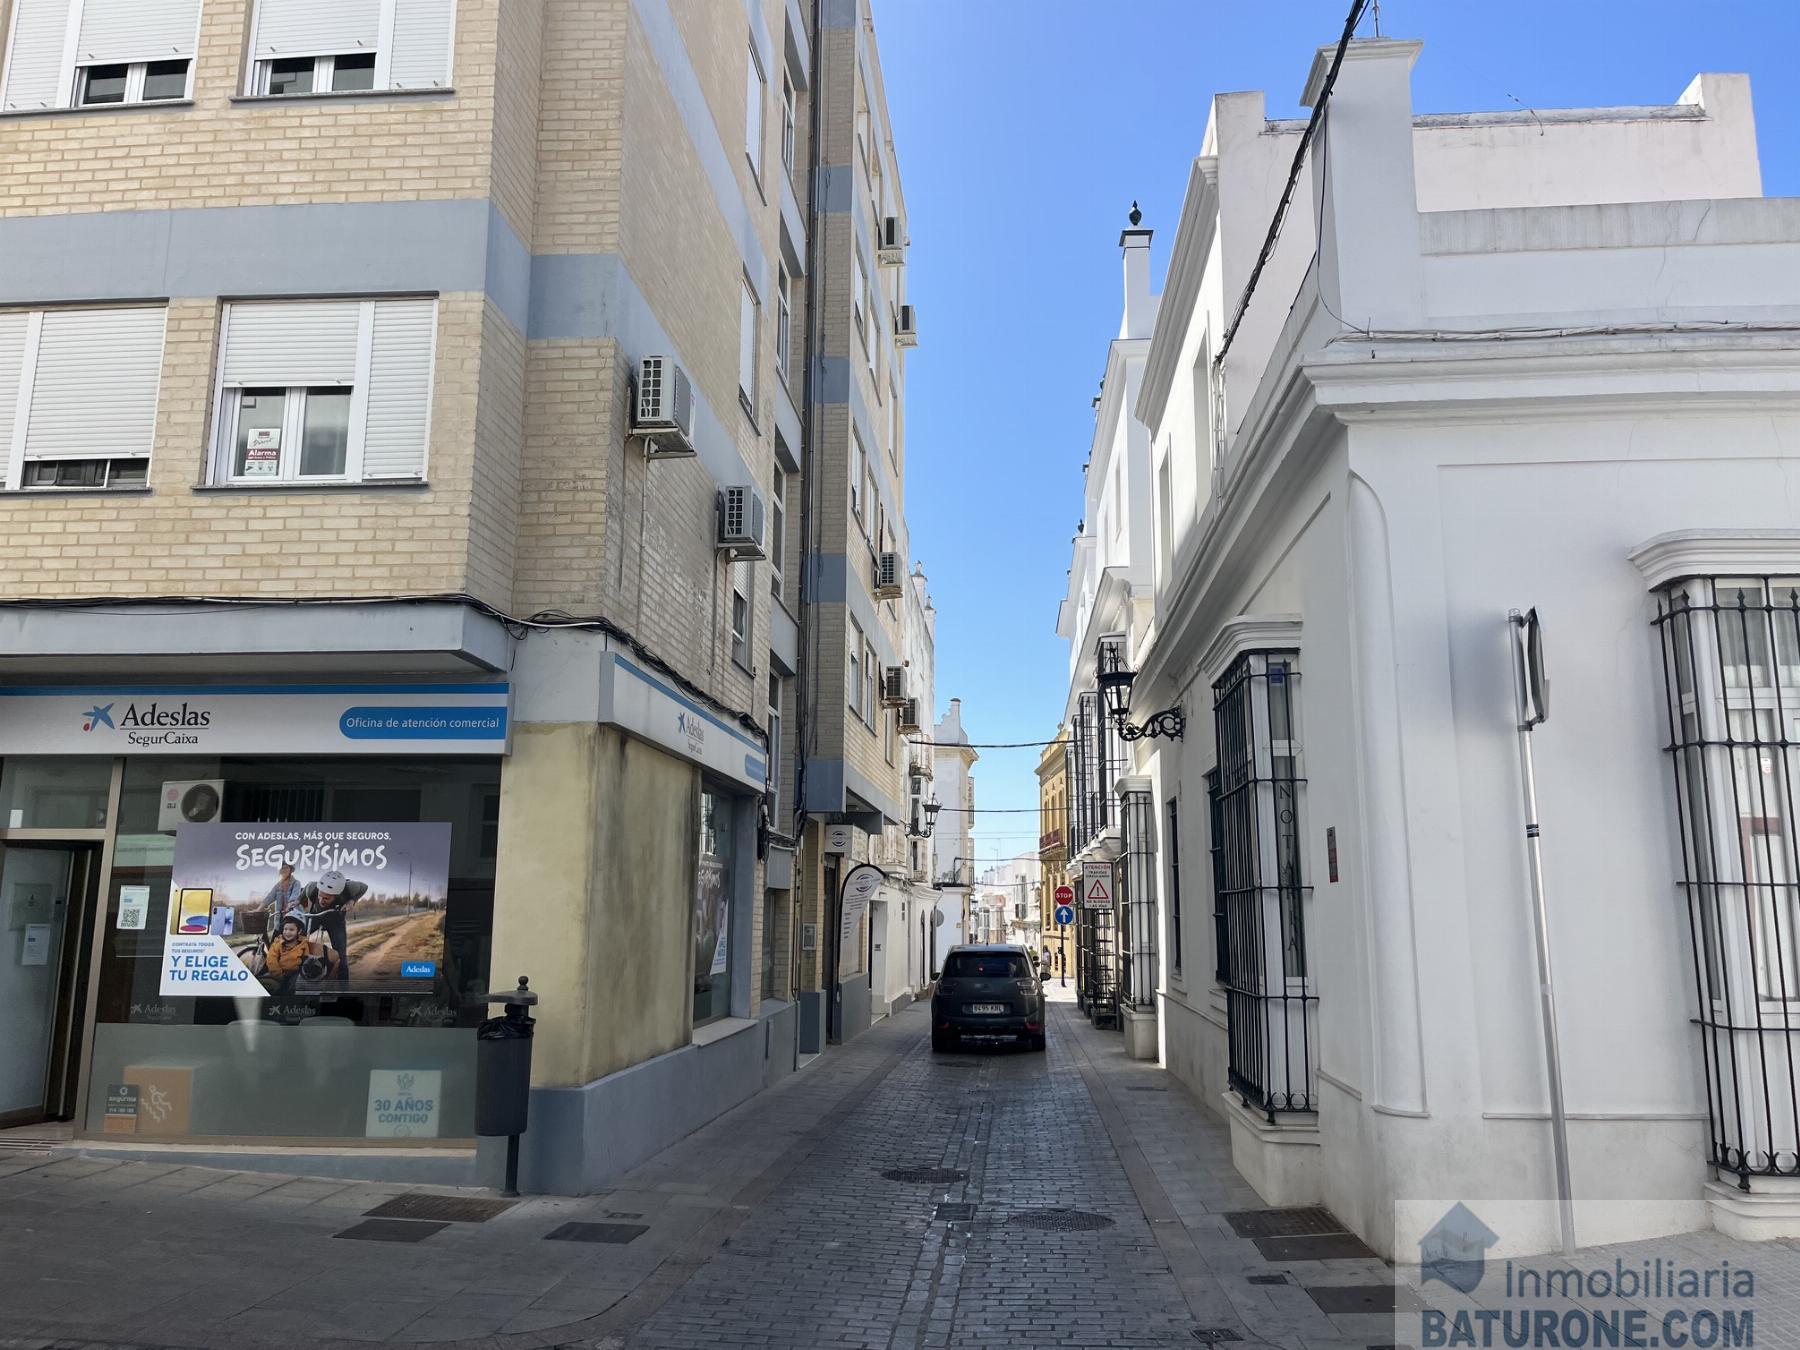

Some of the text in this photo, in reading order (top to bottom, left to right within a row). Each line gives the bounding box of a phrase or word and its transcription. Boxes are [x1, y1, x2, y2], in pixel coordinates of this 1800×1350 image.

[119, 702, 211, 727] Adeslas
[346, 717, 499, 728] Oficina de atención comercial
[687, 715, 705, 742] Adeslas
[127, 731, 198, 748] SegurCaixa
[235, 832, 255, 840] CON
[257, 832, 302, 841] ADESLAS,
[303, 830, 323, 840] MÁS
[324, 832, 345, 841] QUE
[235, 841, 388, 872] SEGURÍSIMOS
[171, 955, 229, 967] Y ELIGE
[406, 965, 431, 973] Adeslas
[169, 970, 249, 982] TU REGALO
[283, 1004, 316, 1015] Adeslas
[374, 1096, 433, 1112] 30 AÑOS
[378, 1113, 429, 1123] CONTIGO
